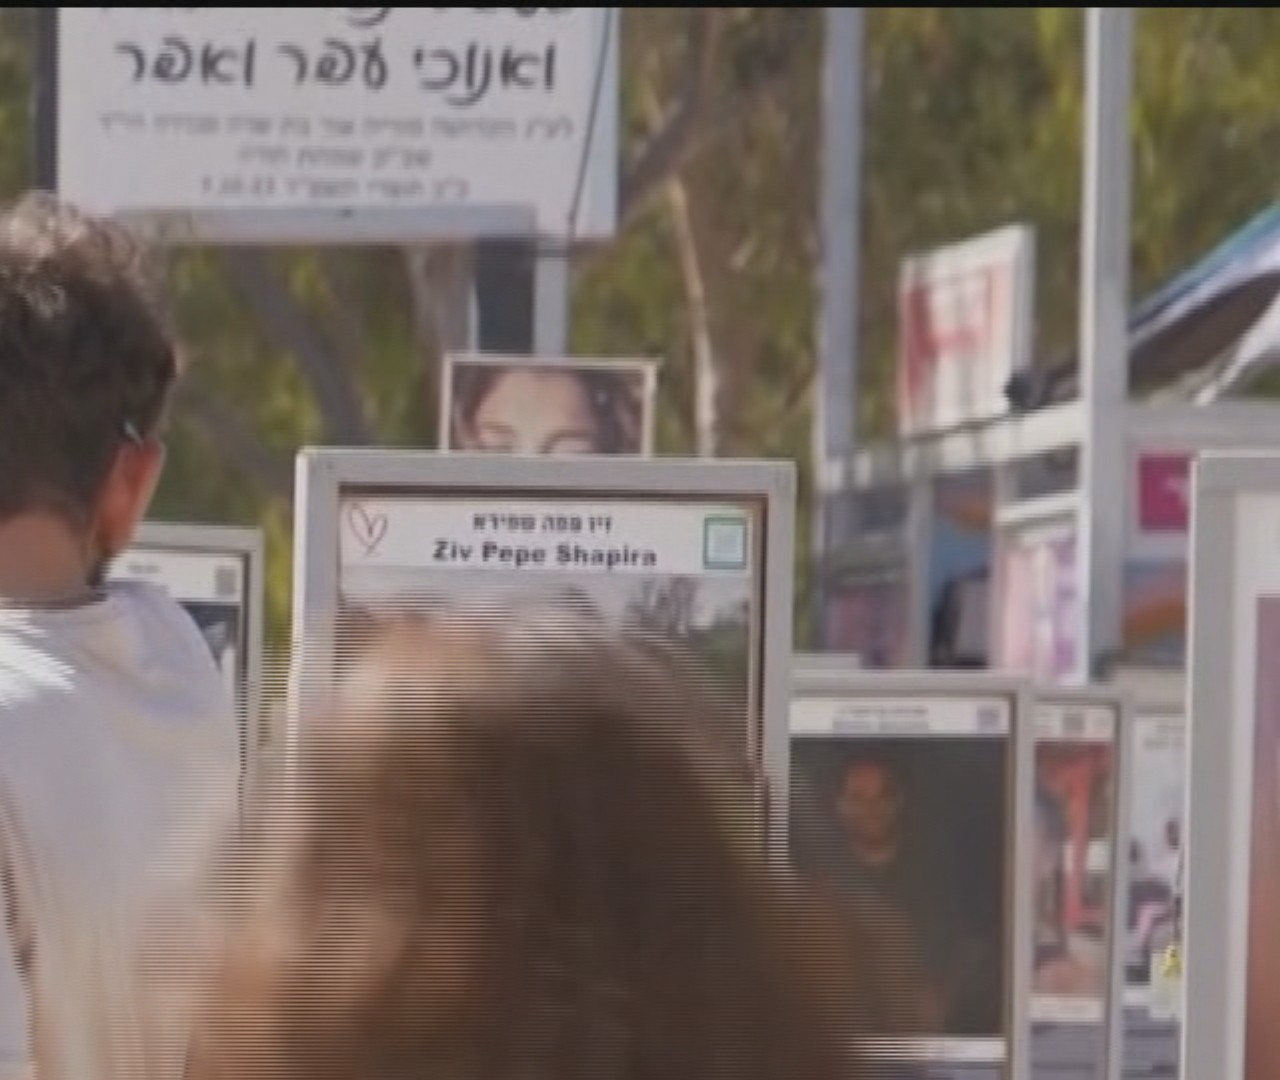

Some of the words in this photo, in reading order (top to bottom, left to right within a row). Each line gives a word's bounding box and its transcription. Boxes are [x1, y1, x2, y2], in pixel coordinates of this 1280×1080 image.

[115, 36, 255, 88] ואפר
[277, 37, 388, 90] עפר
[414, 40, 556, 106] ואנוכי
[432, 538, 473, 562] Ziv
[482, 538, 546, 569] Pepe
[556, 543, 658, 572] Shapira
